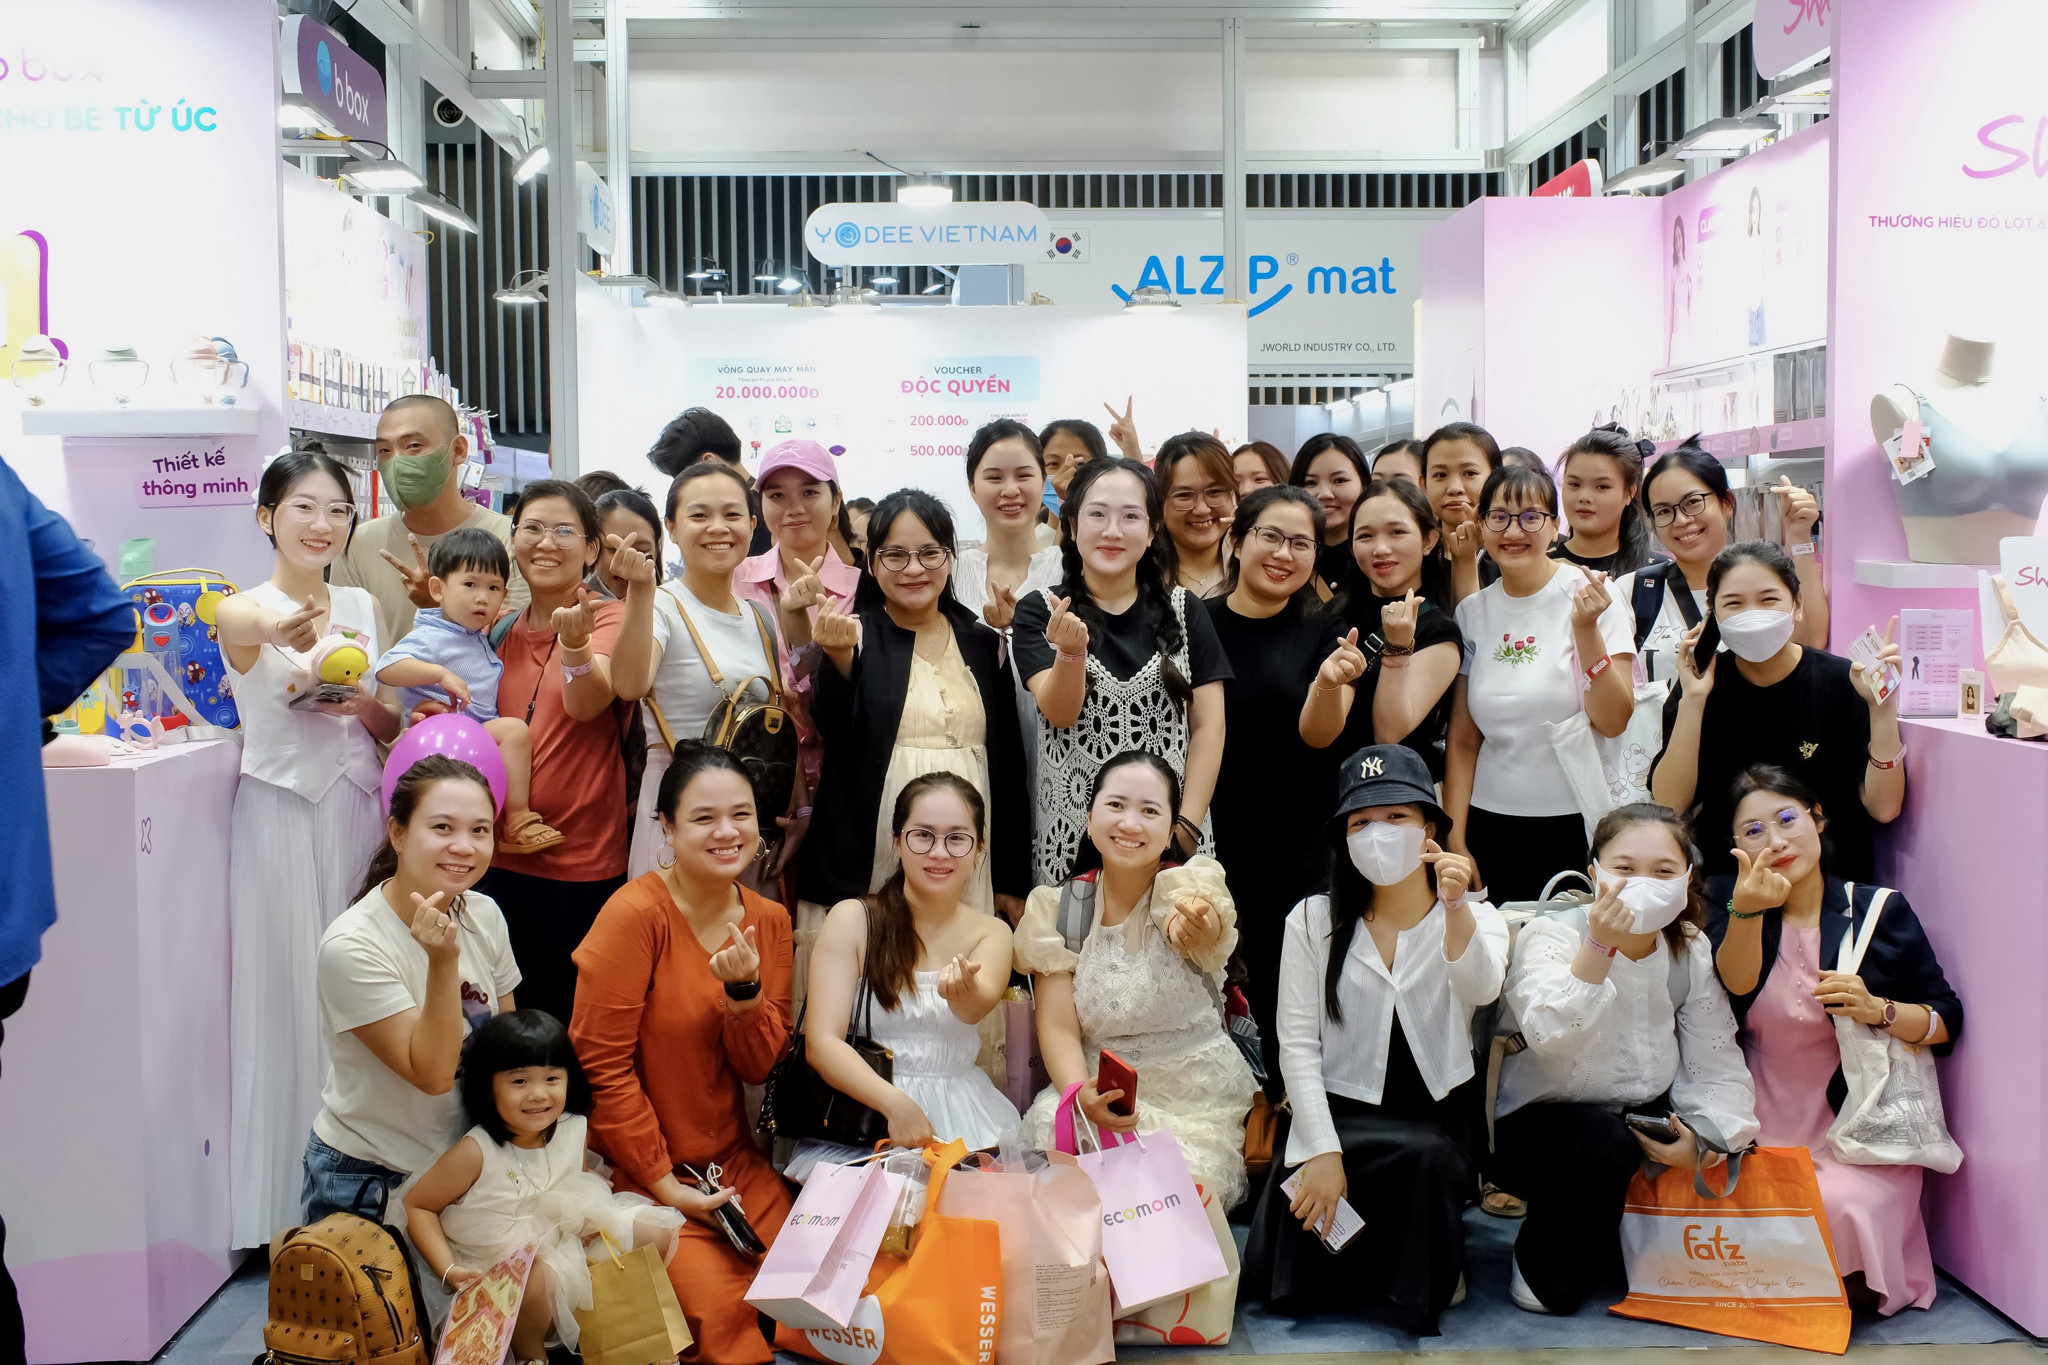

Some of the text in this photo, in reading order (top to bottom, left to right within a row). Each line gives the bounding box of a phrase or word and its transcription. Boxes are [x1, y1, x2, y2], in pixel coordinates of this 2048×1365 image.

[345, 70, 370, 127] box
[112, 98, 163, 133] TỪ
[171, 98, 219, 133] ÚC
[920, 224, 1037, 244] VIETNAM
[1307, 256, 1397, 295] mat
[1260, 342, 1301, 352] JWORLD
[1303, 342, 1352, 352] INDUSTRY
[1377, 342, 1397, 352] LTD.
[746, 365, 771, 374] QUAY
[773, 365, 793, 373] MAY
[934, 366, 982, 375] VOUCHER
[900, 374, 1010, 397] ĐỘC QUYỀN
[152, 446, 226, 474] Thiết kế
[142, 477, 249, 499] thông minh
[1360, 756, 1384, 779] NY
[979, 1285, 997, 1363] WESSER
